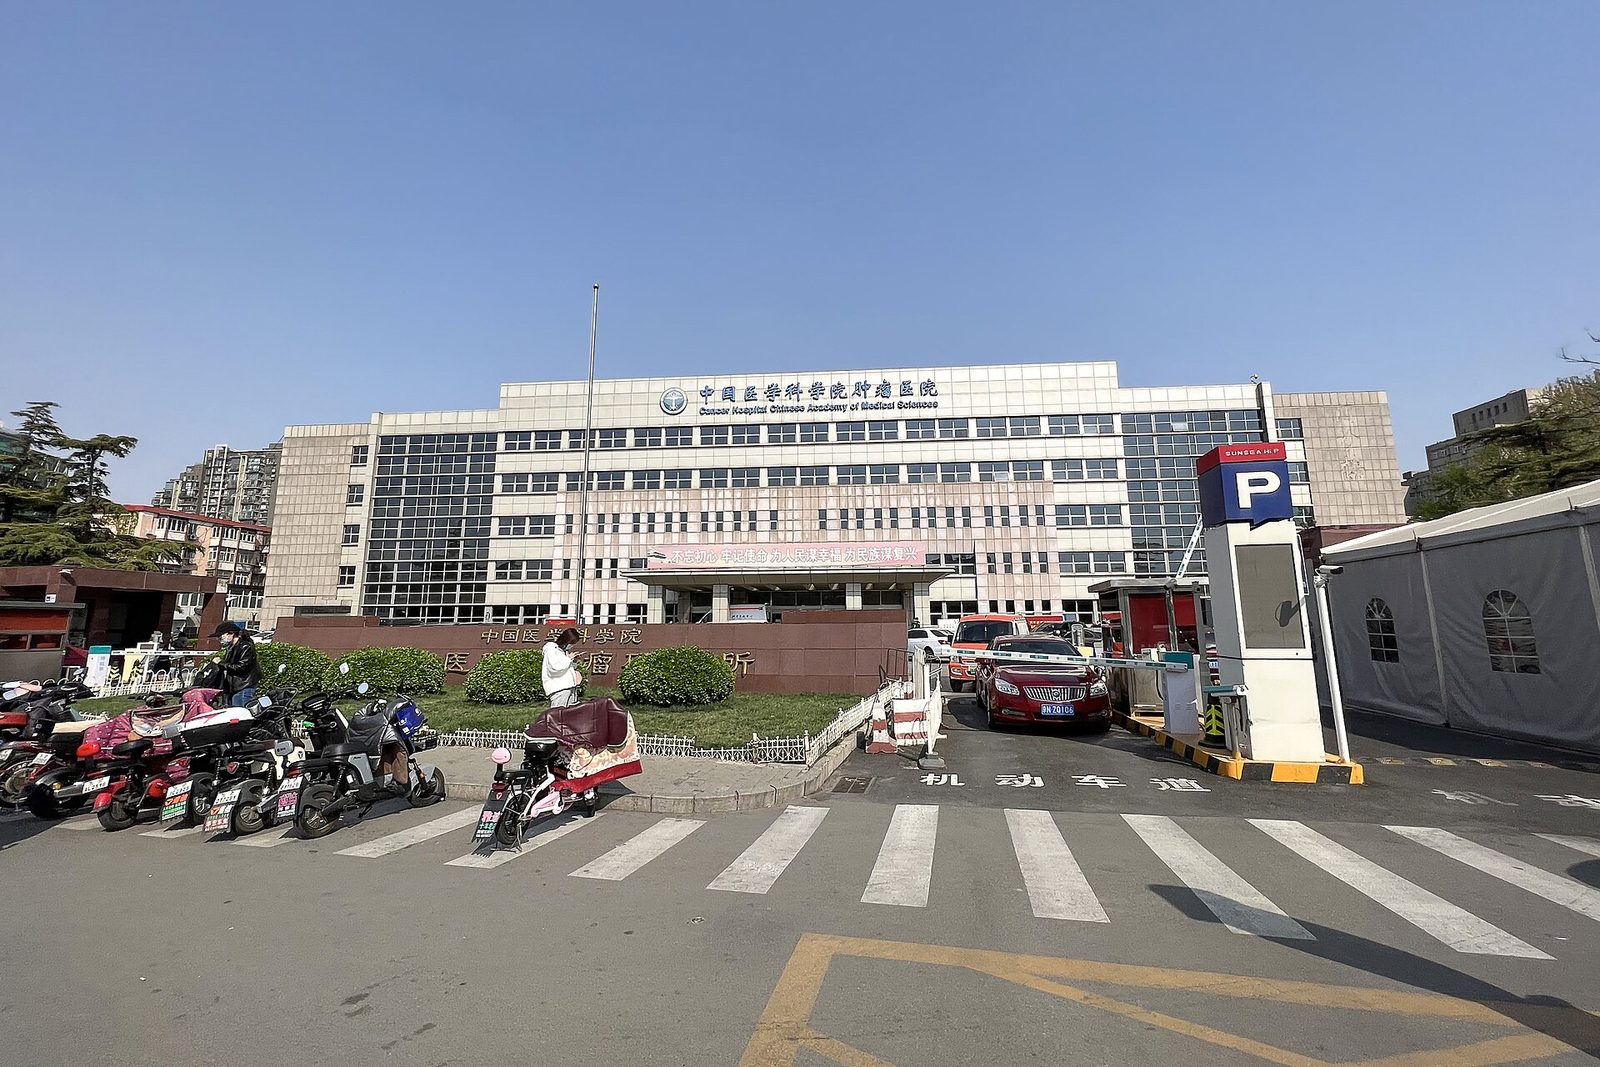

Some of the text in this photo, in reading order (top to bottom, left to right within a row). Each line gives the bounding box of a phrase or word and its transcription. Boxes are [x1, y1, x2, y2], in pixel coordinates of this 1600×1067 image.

[700, 378, 938, 405] 中国医学科学院肿瘤医院
[699, 400, 938, 416] Cancer Hospital Chinese Academy of Medical Sciences
[1235, 471, 1281, 508] P
[672, 546, 917, 564] 不忘初心 牢记使命 为人民谋幸福 为民族谋复兴
[919, 774, 1212, 792] 机动车道
